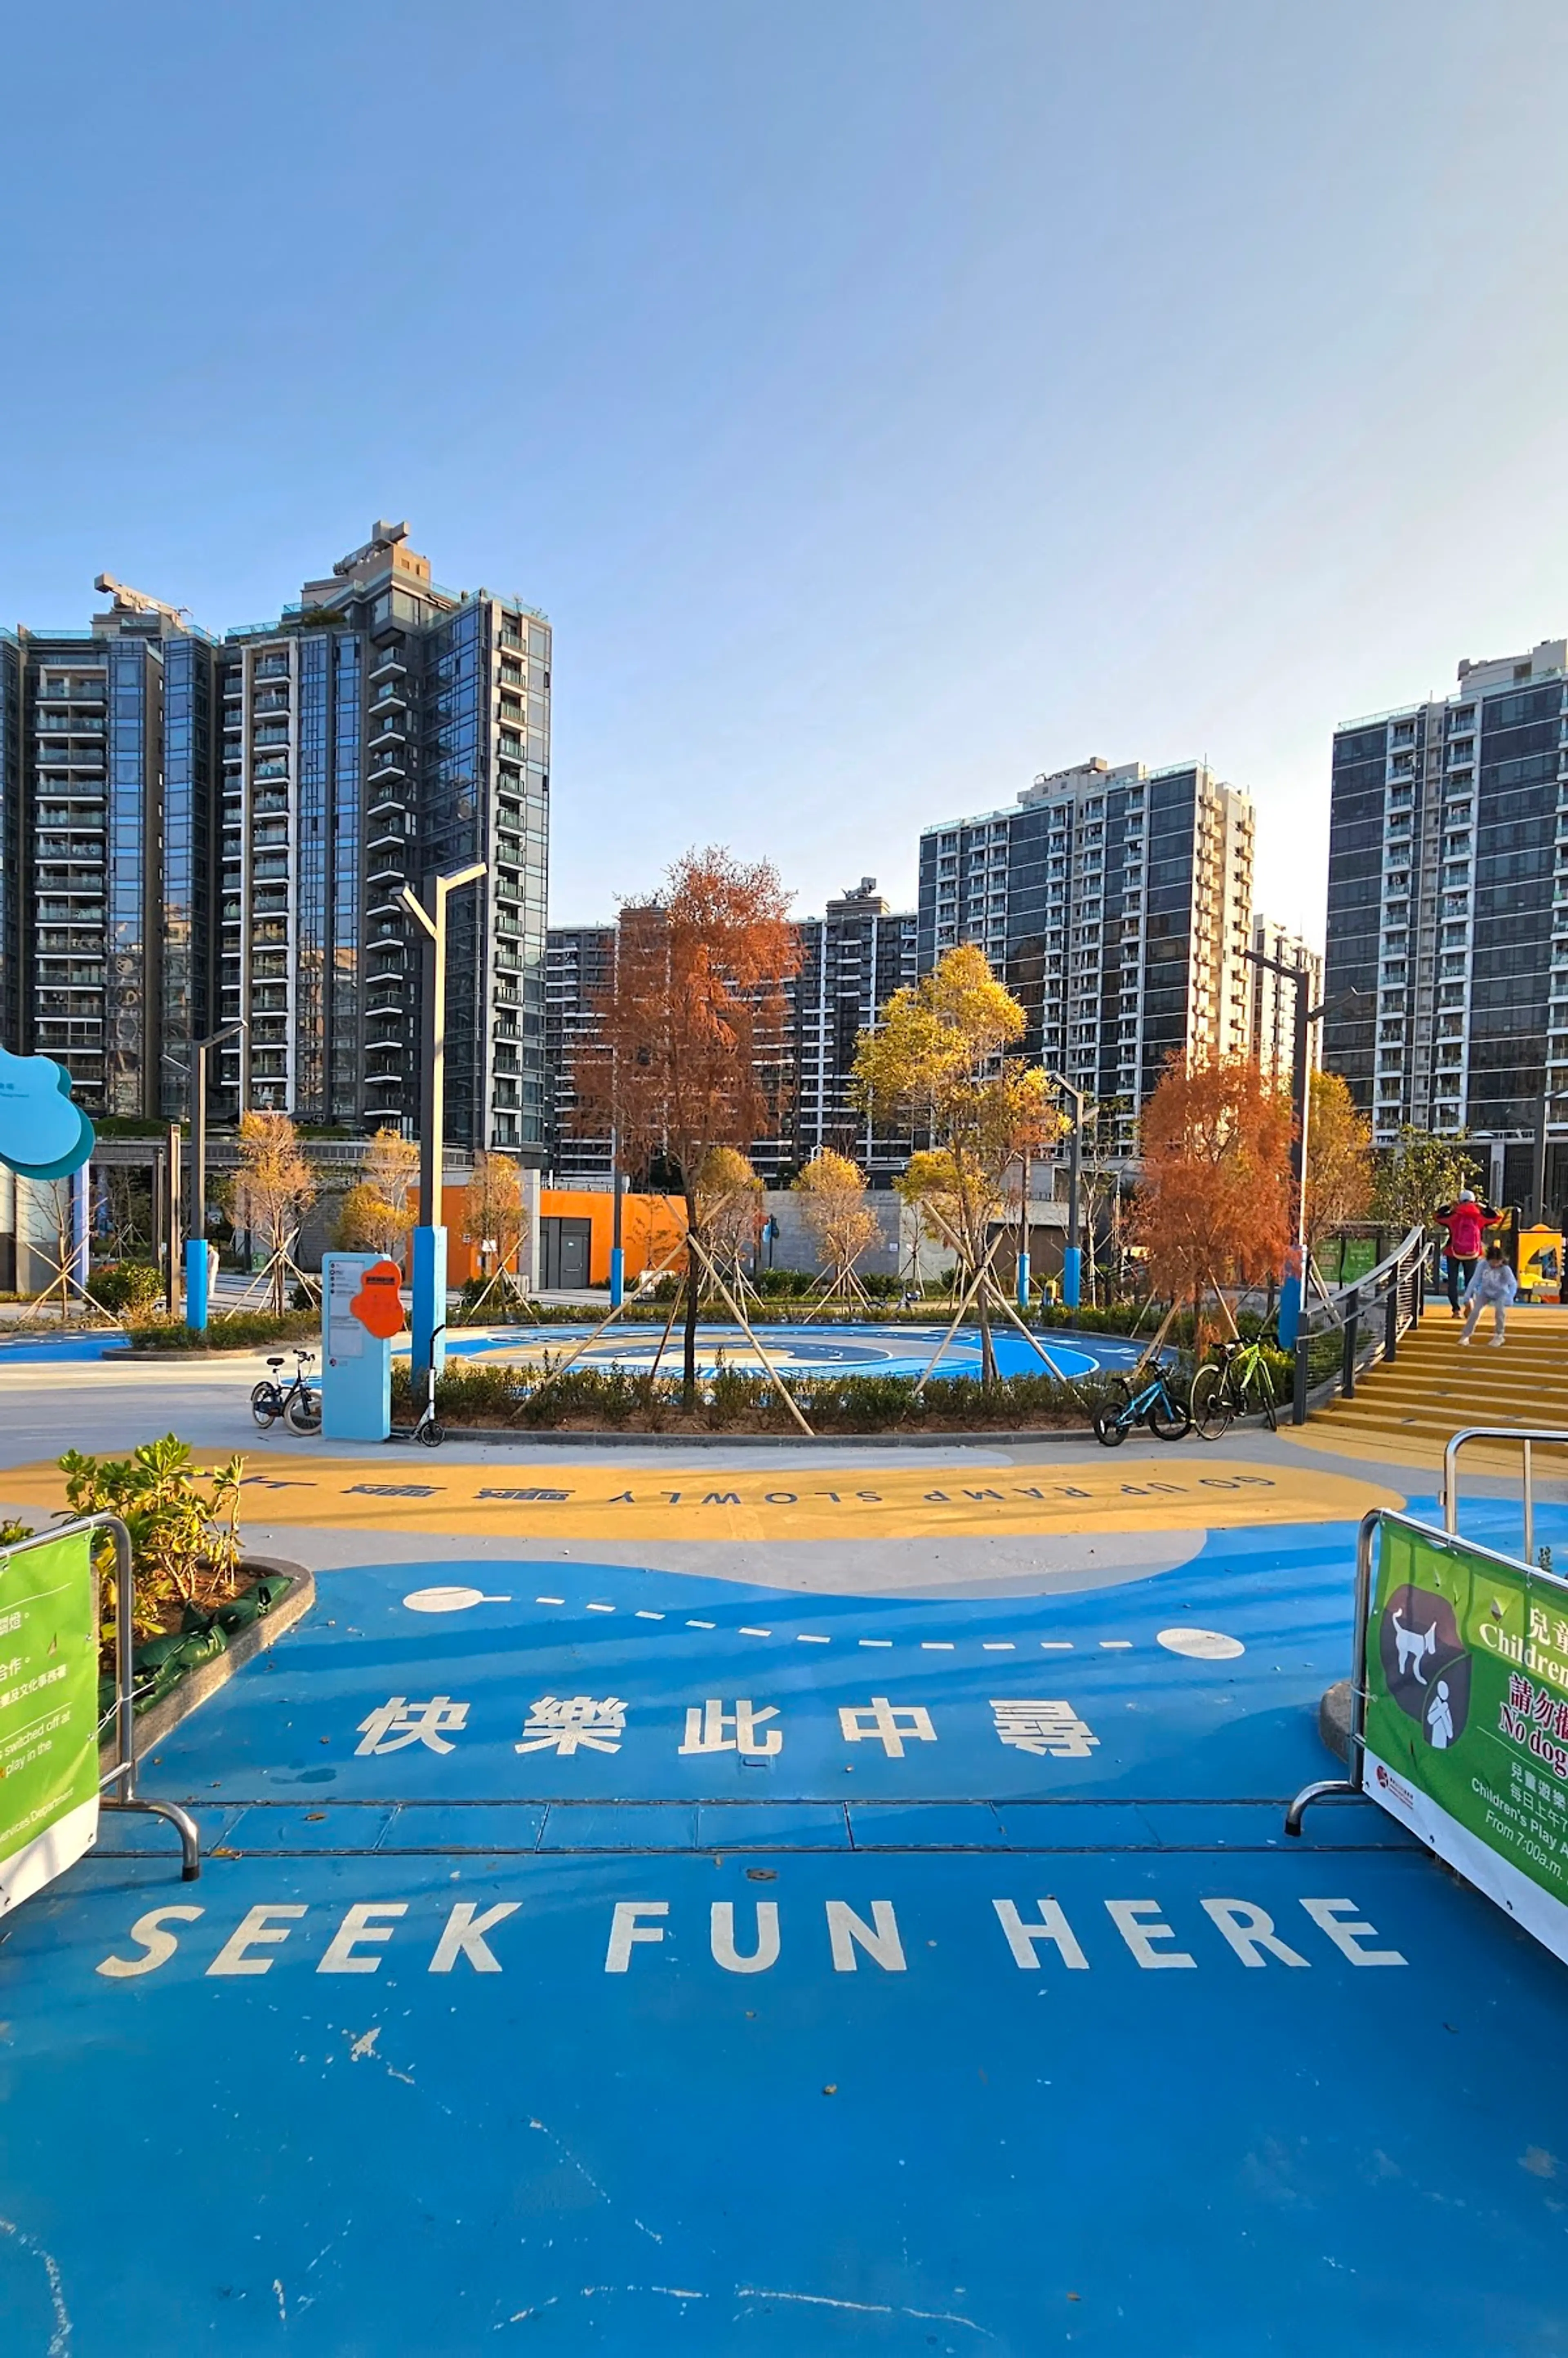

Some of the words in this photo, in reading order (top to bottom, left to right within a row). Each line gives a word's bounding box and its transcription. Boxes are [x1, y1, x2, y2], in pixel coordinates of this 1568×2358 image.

[608, 1490, 884, 1504] SLOWLY
[923, 1486, 1093, 1501] RAMP
[1119, 1482, 1190, 1495] UP
[1199, 1475, 1276, 1489] GO
[5, 1723, 44, 1756] switched
[46, 1714, 61, 1731] off
[61, 1710, 71, 1724] at
[354, 1695, 1101, 1757] 快樂此中尋
[1498, 1701, 1527, 1744] No
[6, 1754, 26, 1778] play
[27, 1749, 36, 1761] in
[38, 1740, 53, 1755] the
[0, 1817, 30, 1843] ervices
[30, 1787, 74, 1822] Department
[1471, 1777, 1527, 1827] Children's
[1530, 1818, 1557, 1850] Play
[1485, 1809, 1514, 1840] From
[1516, 1832, 1563, 1880] 7:00a.m.
[95, 1902, 524, 1978] SEEK
[605, 1901, 907, 1973] FUN
[992, 1898, 1410, 1969] HERE
